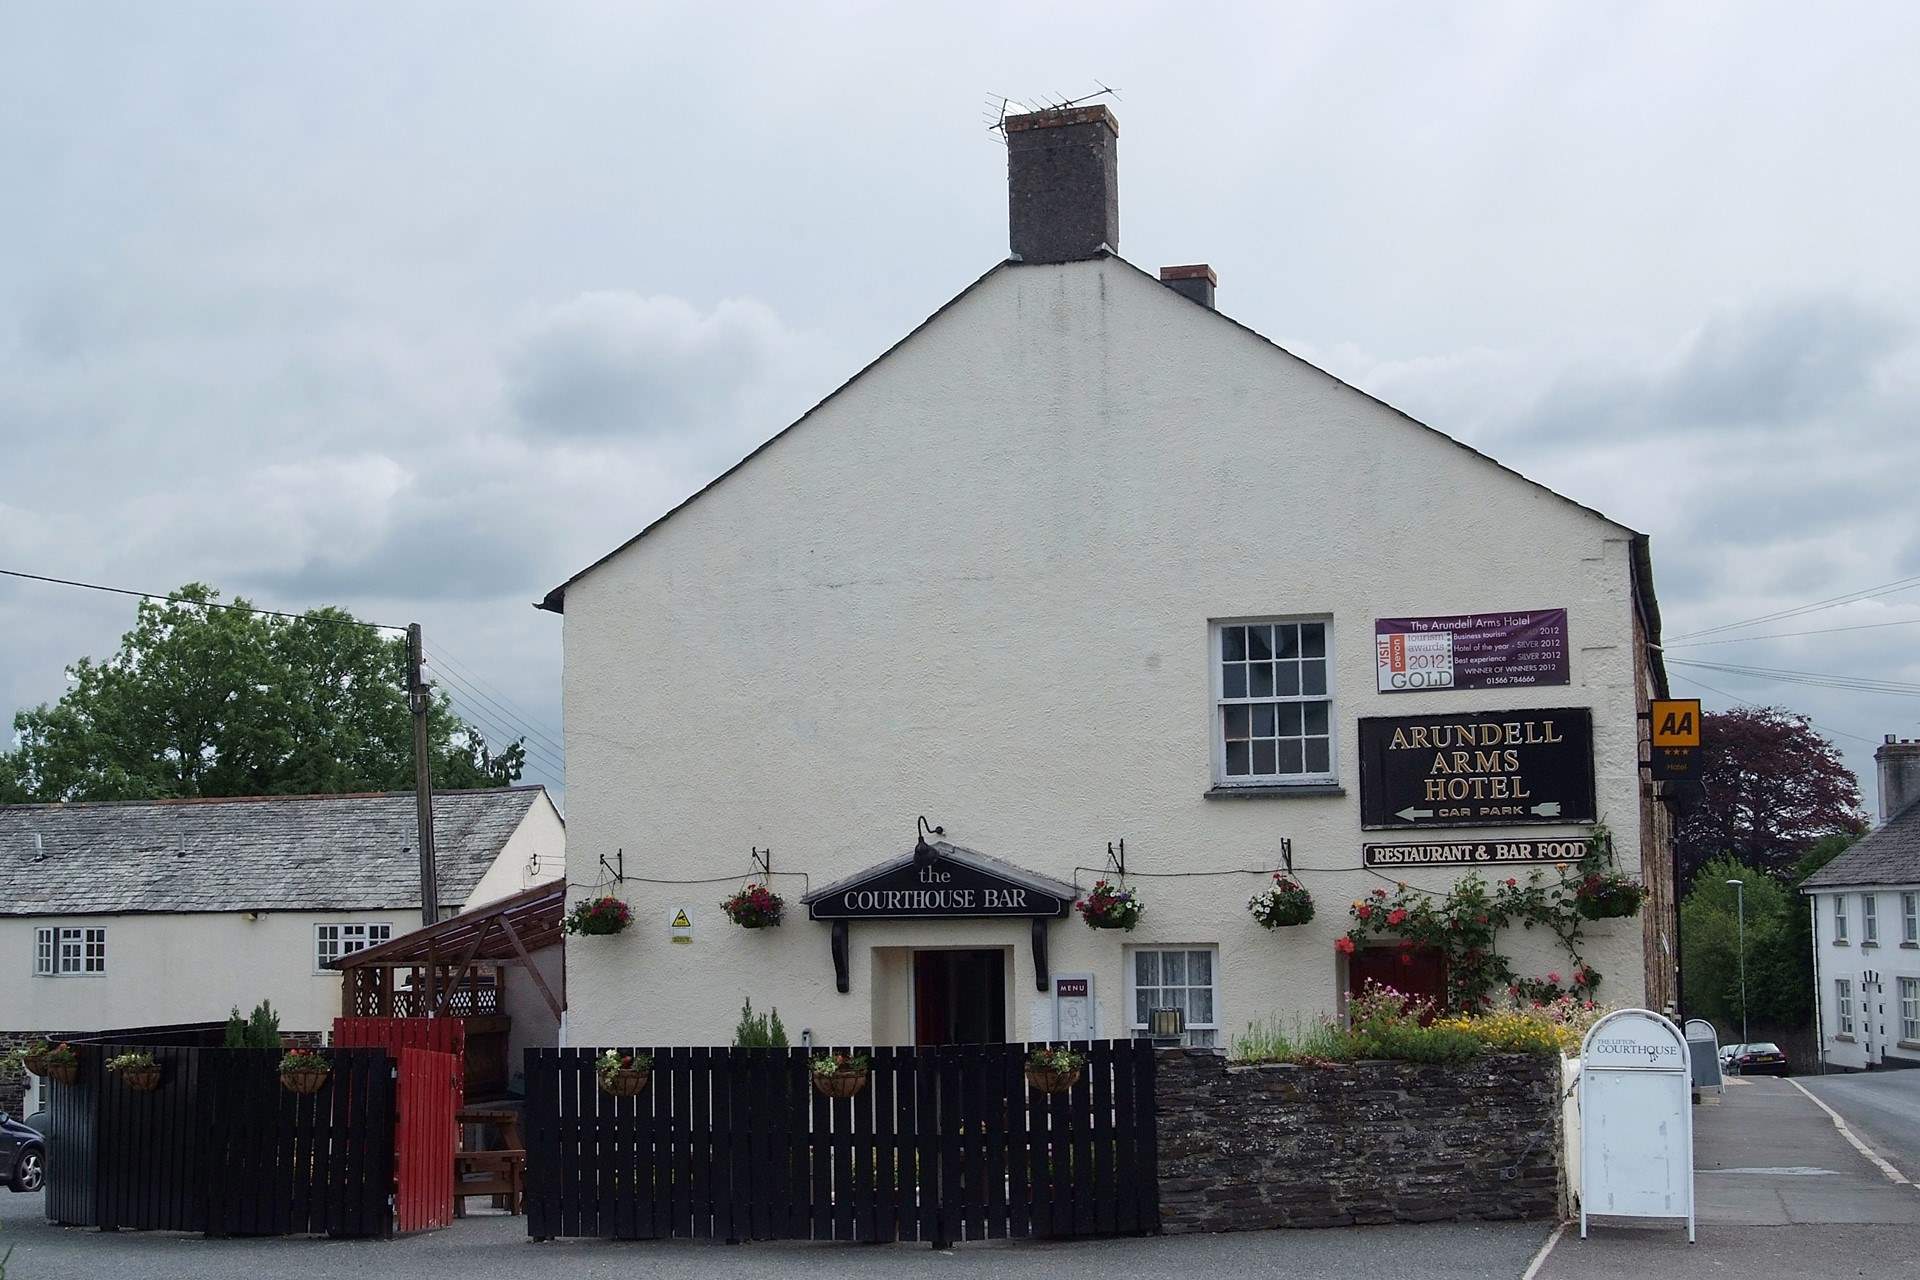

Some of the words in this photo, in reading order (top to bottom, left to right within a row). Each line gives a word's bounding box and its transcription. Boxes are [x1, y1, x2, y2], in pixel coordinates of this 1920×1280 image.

[1411, 621, 1428, 631] The
[1431, 618, 1472, 631] Arundell
[1475, 618, 1501, 628] Arms
[1504, 615, 1530, 626] Hotel
[1407, 633, 1445, 642] tourism
[1482, 631, 1507, 639] tourism
[1540, 627, 1560, 635] 2012
[1408, 642, 1445, 652] awards
[1453, 643, 1472, 652] Hotel
[1473, 643, 1480, 651] of
[1481, 643, 1493, 651] the
[1494, 643, 1509, 653] year
[1541, 639, 1561, 648] 2012
[1409, 654, 1445, 670] 2012
[1469, 655, 1507, 665] experience
[1542, 651, 1561, 660] 2012
[1464, 667, 1493, 675] WINNER
[1505, 665, 1538, 673] WINNERS
[1539, 663, 1556, 671] 2012
[1391, 671, 1453, 689] GOLD
[1659, 712, 1692, 736] AA
[1389, 720, 1564, 750] ARUNDELL
[1430, 750, 1520, 775] ARMS
[1424, 775, 1531, 801] HOTEL
[1438, 807, 1471, 817] CAR
[1479, 806, 1524, 816] PARK
[1374, 845, 1473, 863] RESTAURANT
[1474, 844, 1491, 860] &
[1495, 843, 1532, 860] BAR
[1537, 842, 1587, 859] FOOD
[919, 865, 951, 883] the
[844, 889, 976, 910] COURTHOUSE
[983, 888, 1028, 909] BAR
[1597, 1044, 1677, 1056] COURTHOUSE
